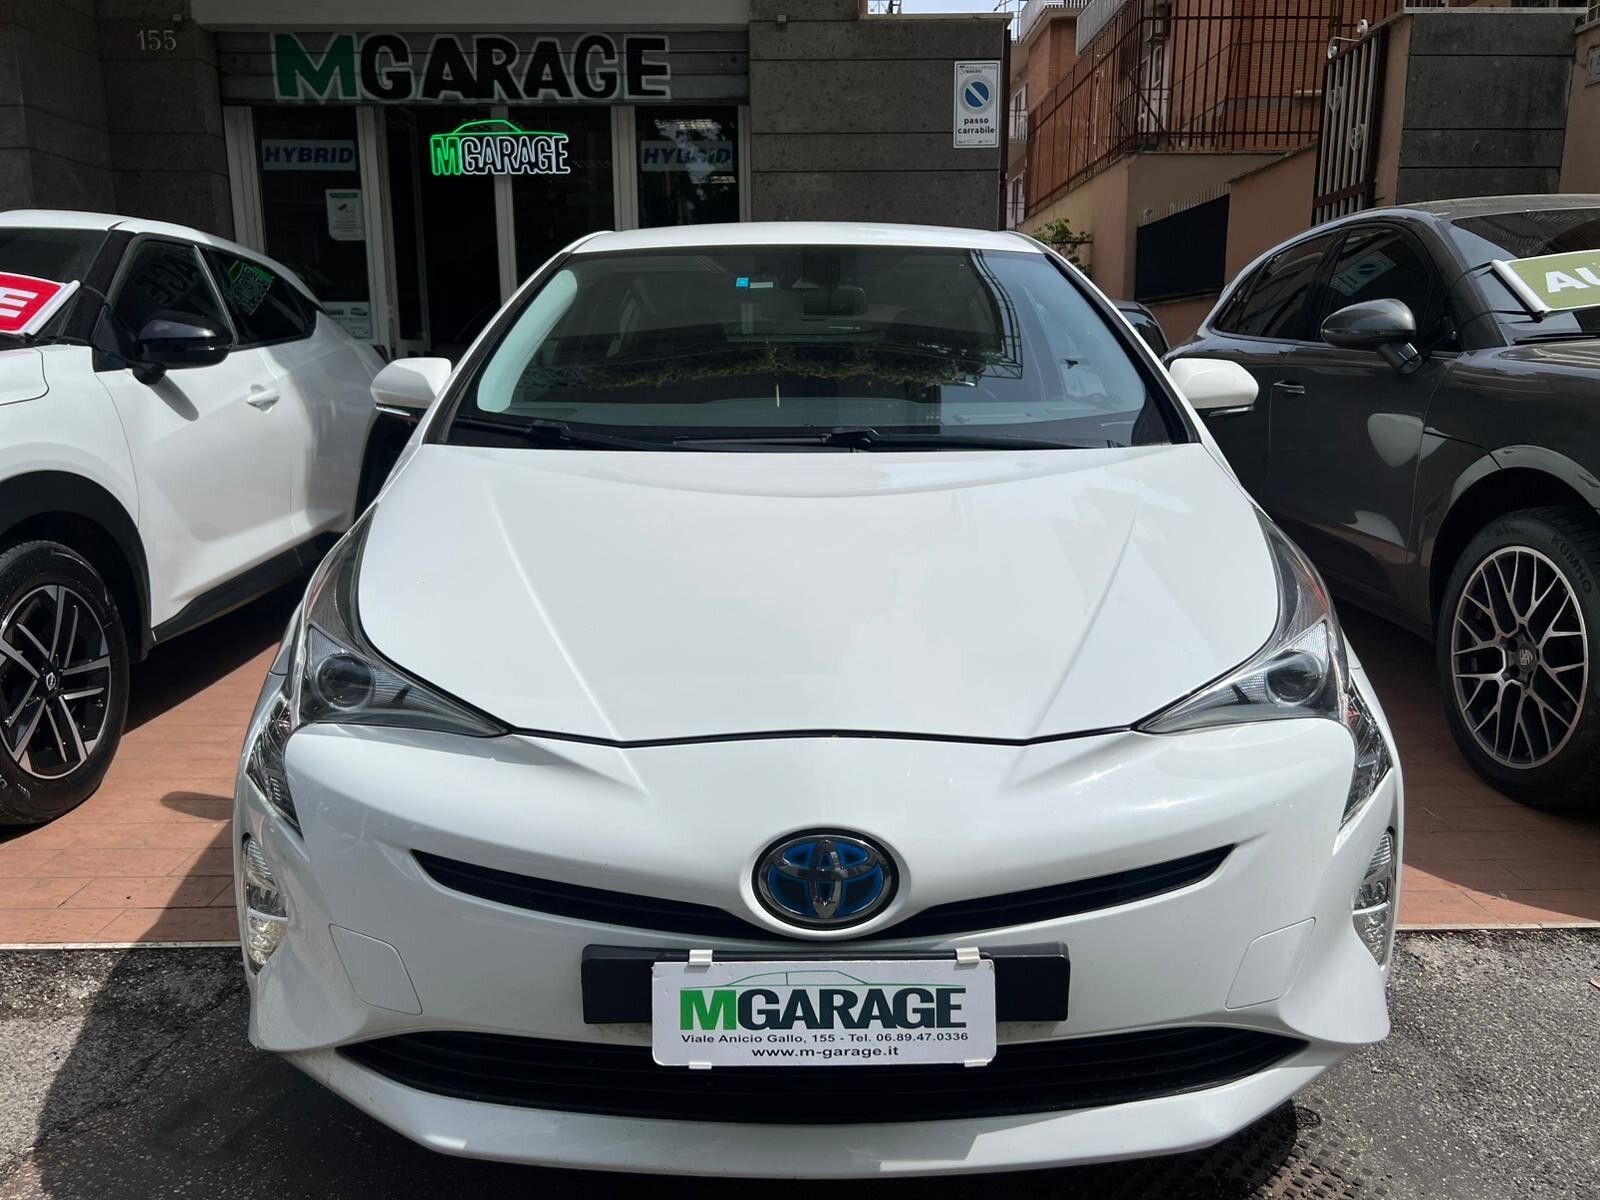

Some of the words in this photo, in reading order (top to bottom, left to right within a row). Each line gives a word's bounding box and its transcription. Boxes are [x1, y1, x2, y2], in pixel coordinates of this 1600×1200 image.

[137, 29, 177, 51] 155
[272, 33, 672, 102] MGARAGE
[957, 126, 995, 134] carrabile
[264, 146, 354, 163] HYBRID
[430, 136, 571, 176] MGARAGE
[1551, 532, 1592, 594] KUMHO
[680, 988, 966, 1031] MGARAGE
[682, 1034, 715, 1043] Viale
[718, 1034, 762, 1043] Anicio
[767, 1034, 807, 1044] Gallo,
[812, 1034, 835, 1042] 155
[850, 1033, 872, 1042] Tel.
[876, 1032, 968, 1041] 06.89.47.0336
[752, 1046, 899, 1059] www.m-garage.it
